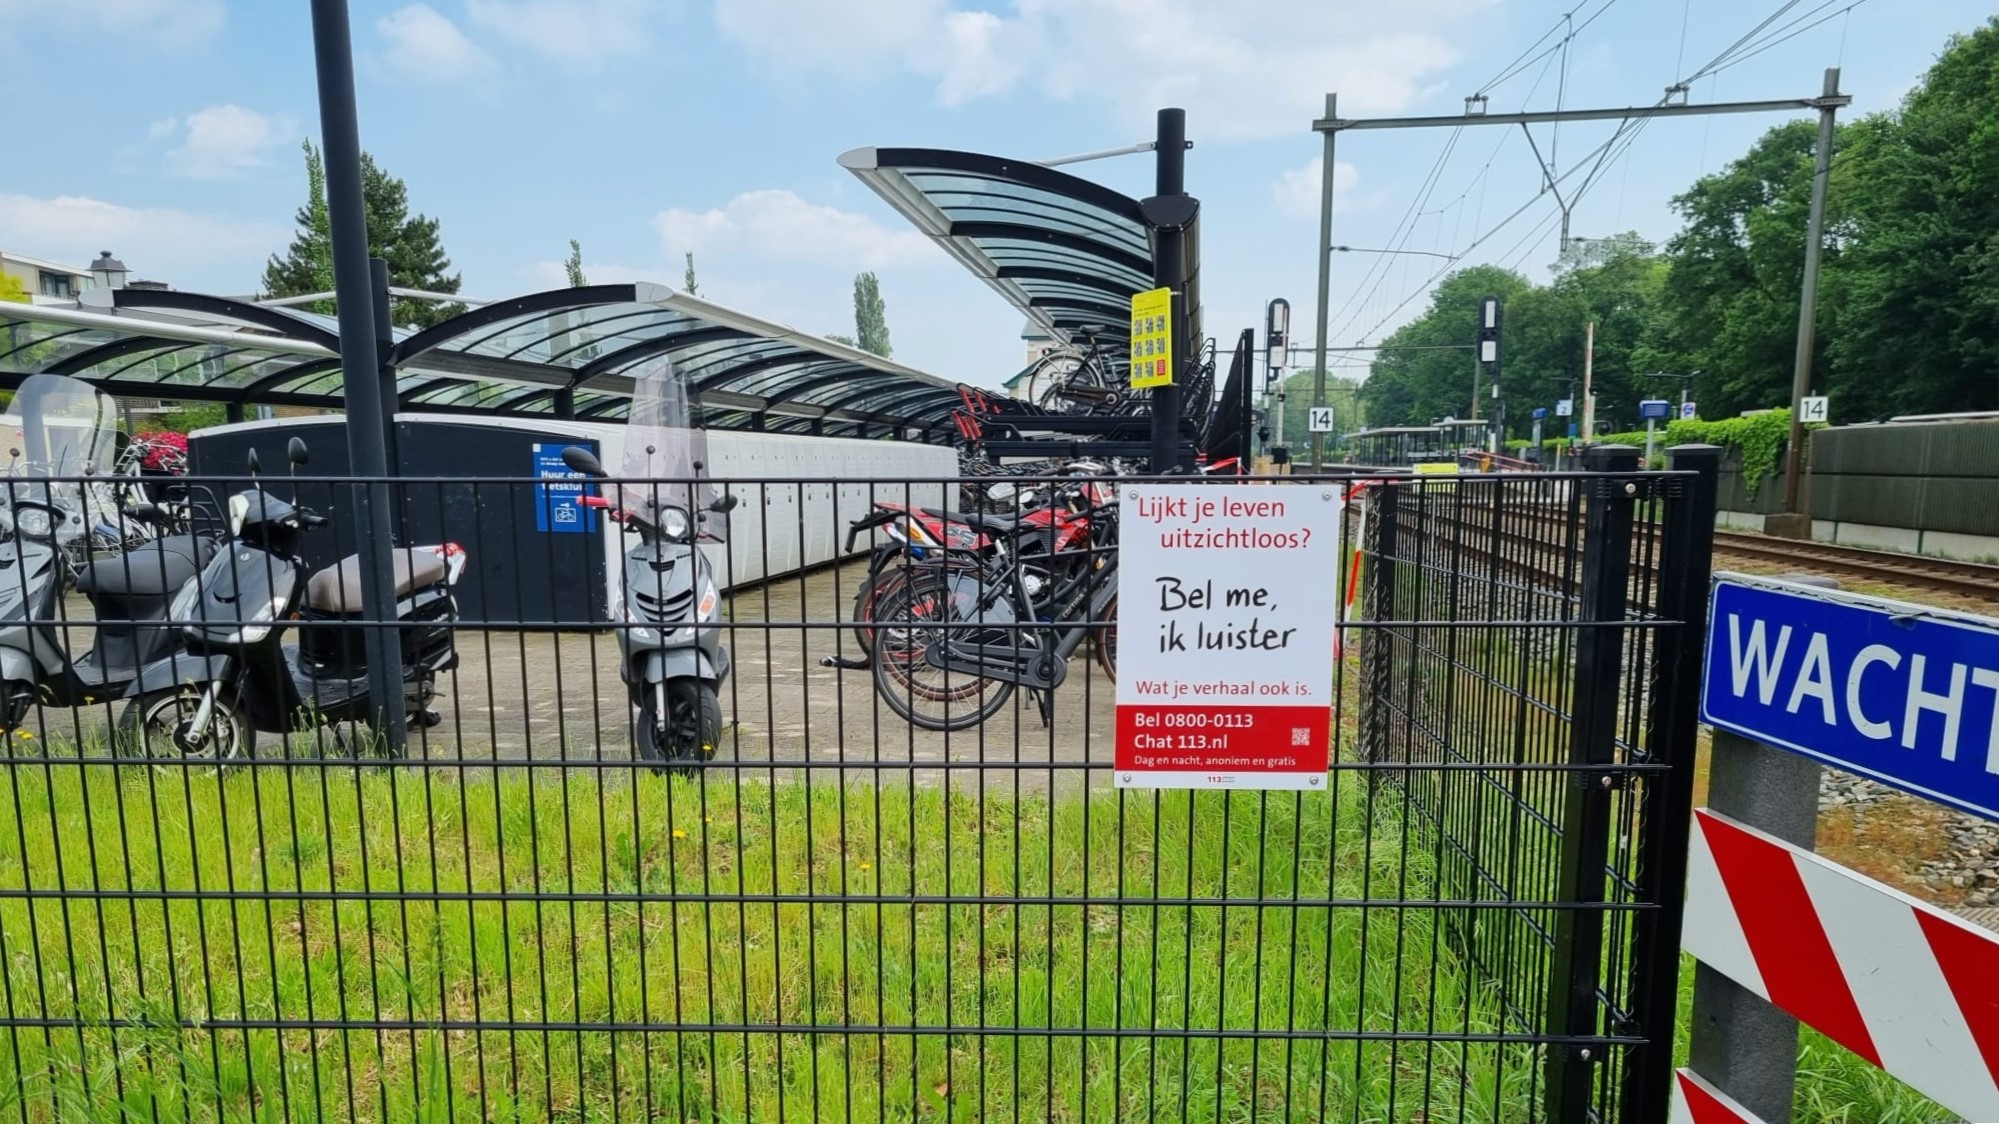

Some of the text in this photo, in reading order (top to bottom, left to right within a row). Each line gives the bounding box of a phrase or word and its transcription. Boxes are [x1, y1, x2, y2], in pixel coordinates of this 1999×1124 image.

[1804, 400, 1824, 419] 14
[1312, 410, 1331, 429] 14
[1139, 496, 1285, 524] Lijkt je leven
[1161, 527, 1311, 549] uitzichtloos?
[1155, 576, 1277, 612] Bel me,
[1160, 617, 1297, 653] ik luister
[1136, 680, 1312, 699] Wat je verhaal ook is.
[1728, 612, 1999, 776] WACHT
[1135, 712, 1253, 728] Bel 0800-0113
[1134, 734, 1228, 749] Chat 113.nl
[1134, 755, 1296, 768] Dag en nacht, anoniem en gratis
